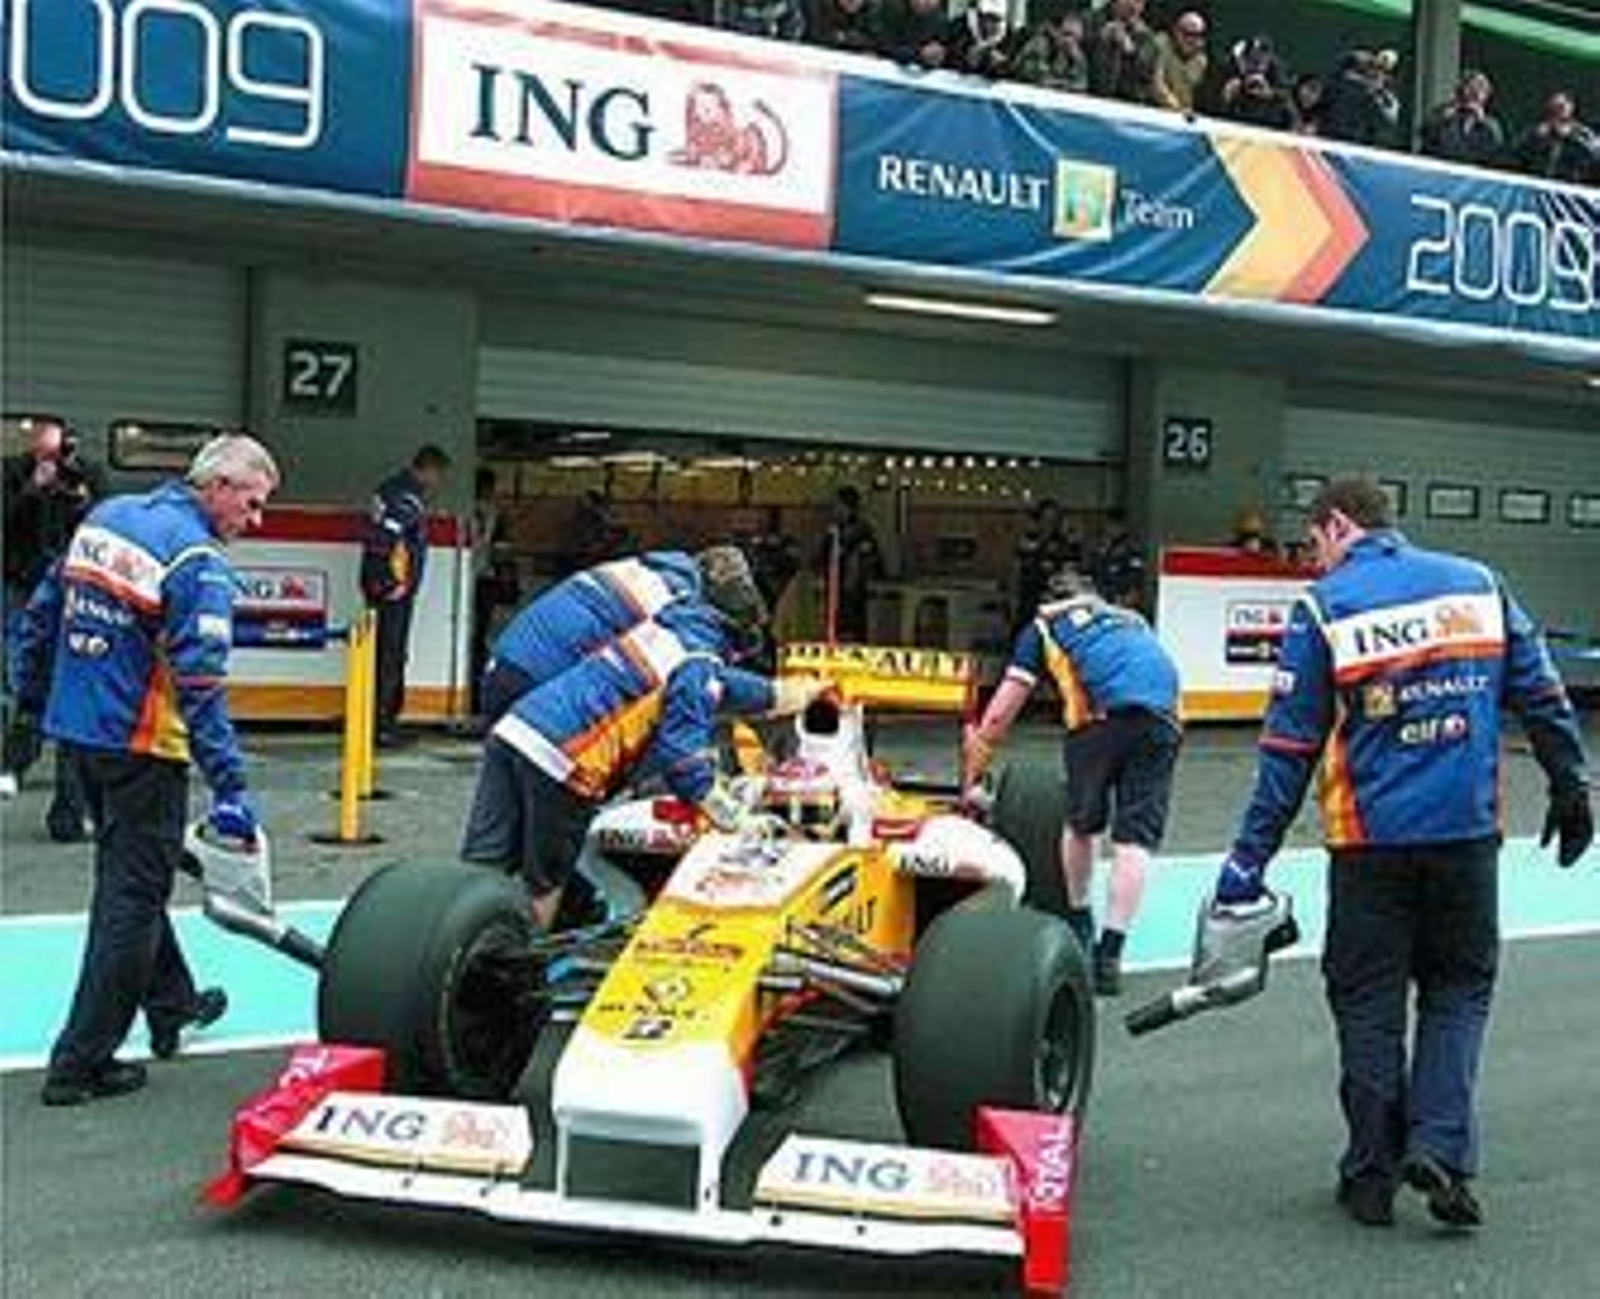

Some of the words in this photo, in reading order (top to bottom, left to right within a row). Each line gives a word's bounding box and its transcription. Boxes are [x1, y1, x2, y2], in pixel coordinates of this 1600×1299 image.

[468, 62, 656, 161] ING
[878, 153, 1048, 211] RENAULT
[1407, 193, 1594, 313] 2009
[290, 350, 352, 398] 27
[1167, 423, 1208, 461] 26
[1354, 618, 1428, 654] ING
[1400, 717, 1439, 744] elf
[315, 1106, 426, 1141] ING
[791, 1152, 911, 1192] ING
